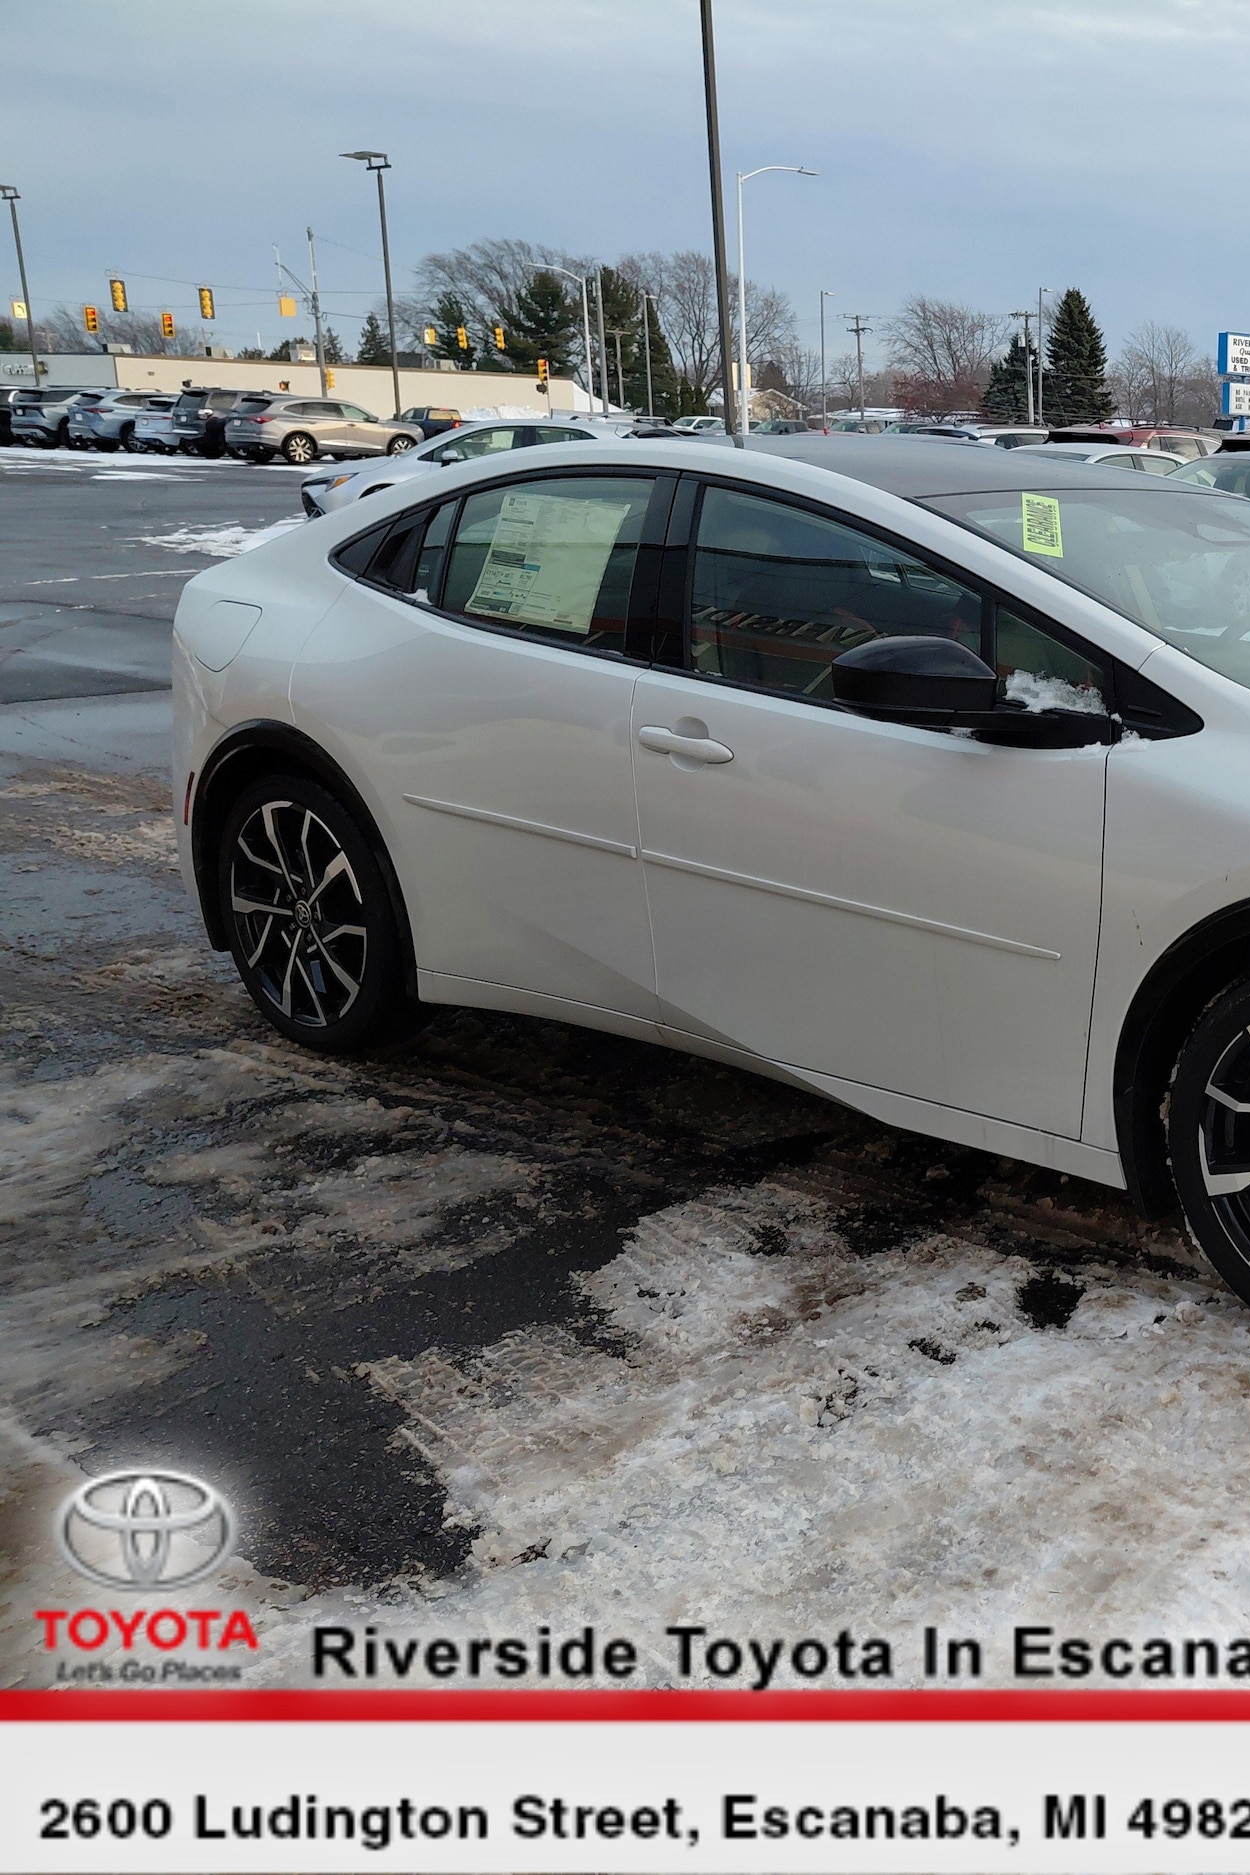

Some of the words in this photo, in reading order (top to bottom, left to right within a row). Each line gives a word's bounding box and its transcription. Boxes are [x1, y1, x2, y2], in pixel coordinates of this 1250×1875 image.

[1231, 356, 1248, 365] USED
[1233, 364, 1237, 372] &
[1026, 499, 1055, 548] CLEARANCE
